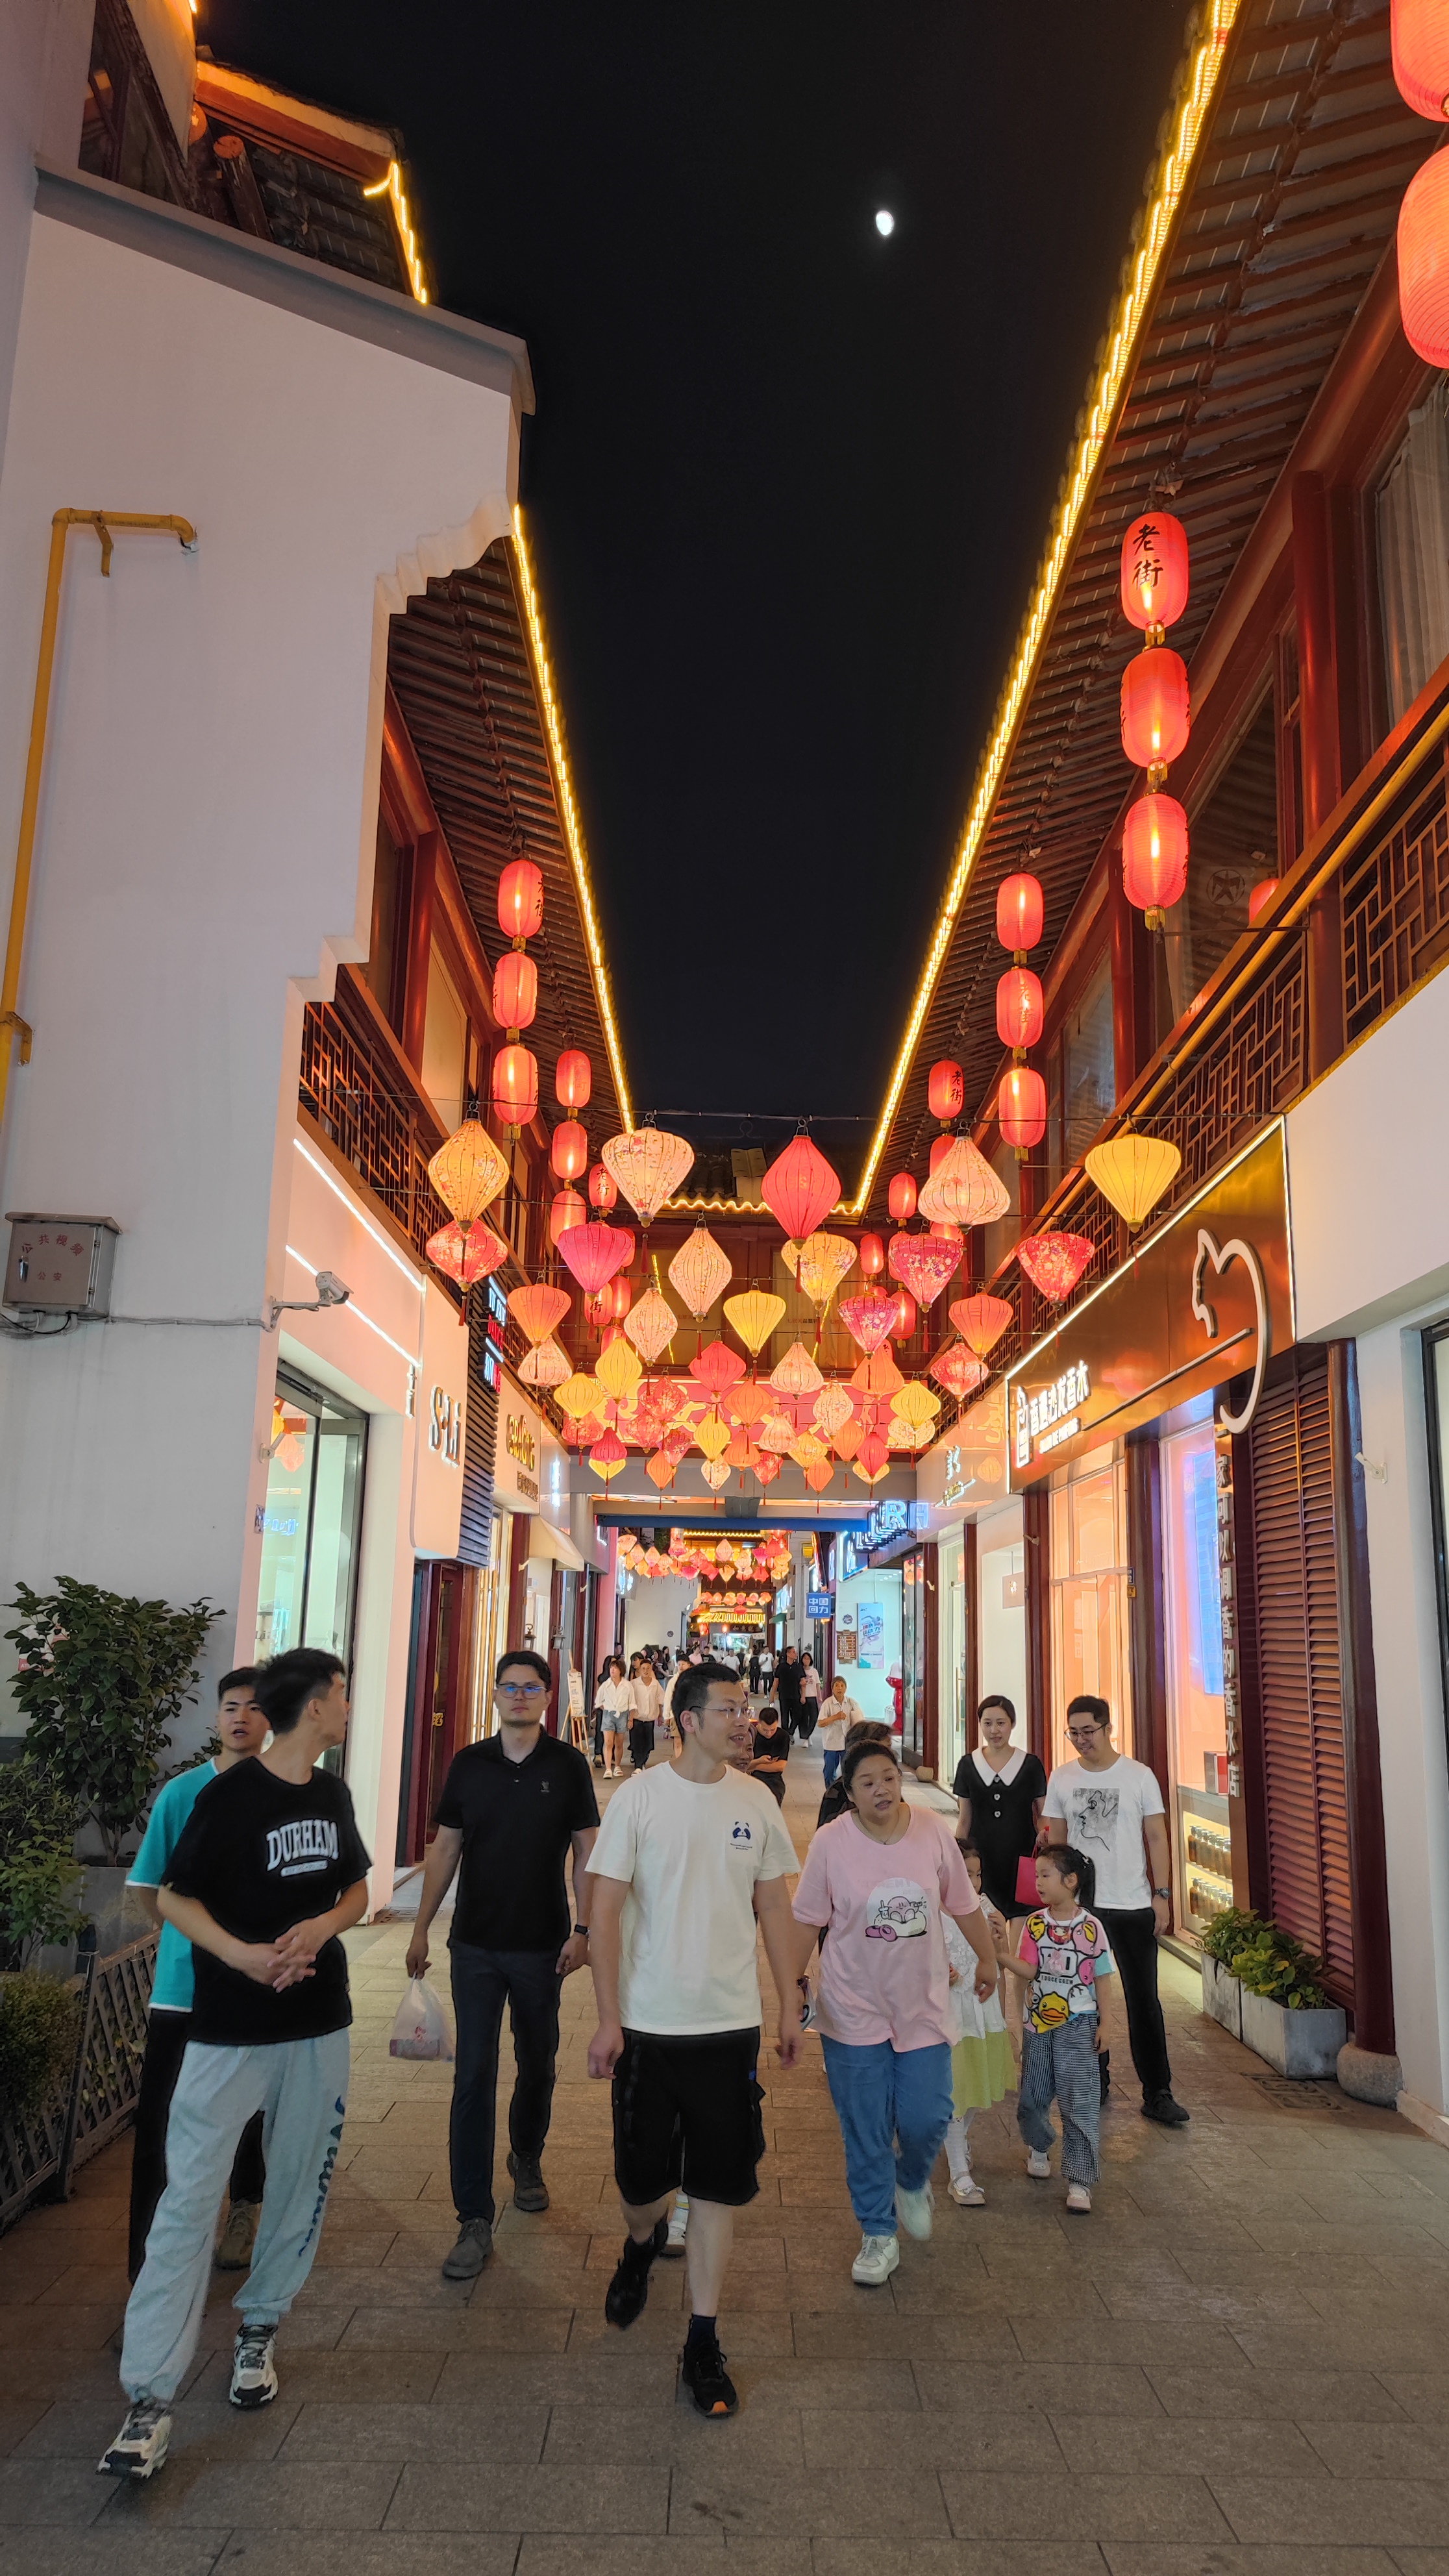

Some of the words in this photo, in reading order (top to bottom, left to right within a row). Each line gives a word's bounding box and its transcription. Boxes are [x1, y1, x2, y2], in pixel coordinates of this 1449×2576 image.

[1132, 523, 1164, 590] 老街
[950, 1070, 963, 1105] 老街
[597, 1167, 610, 1197] 老街
[37, 1271, 62, 1282] 公安
[808, 1605, 829, 1614] 回力
[1215, 1428, 1240, 1798] 一家可以调香的香水店
[266, 1818, 340, 1872] DURHAM
